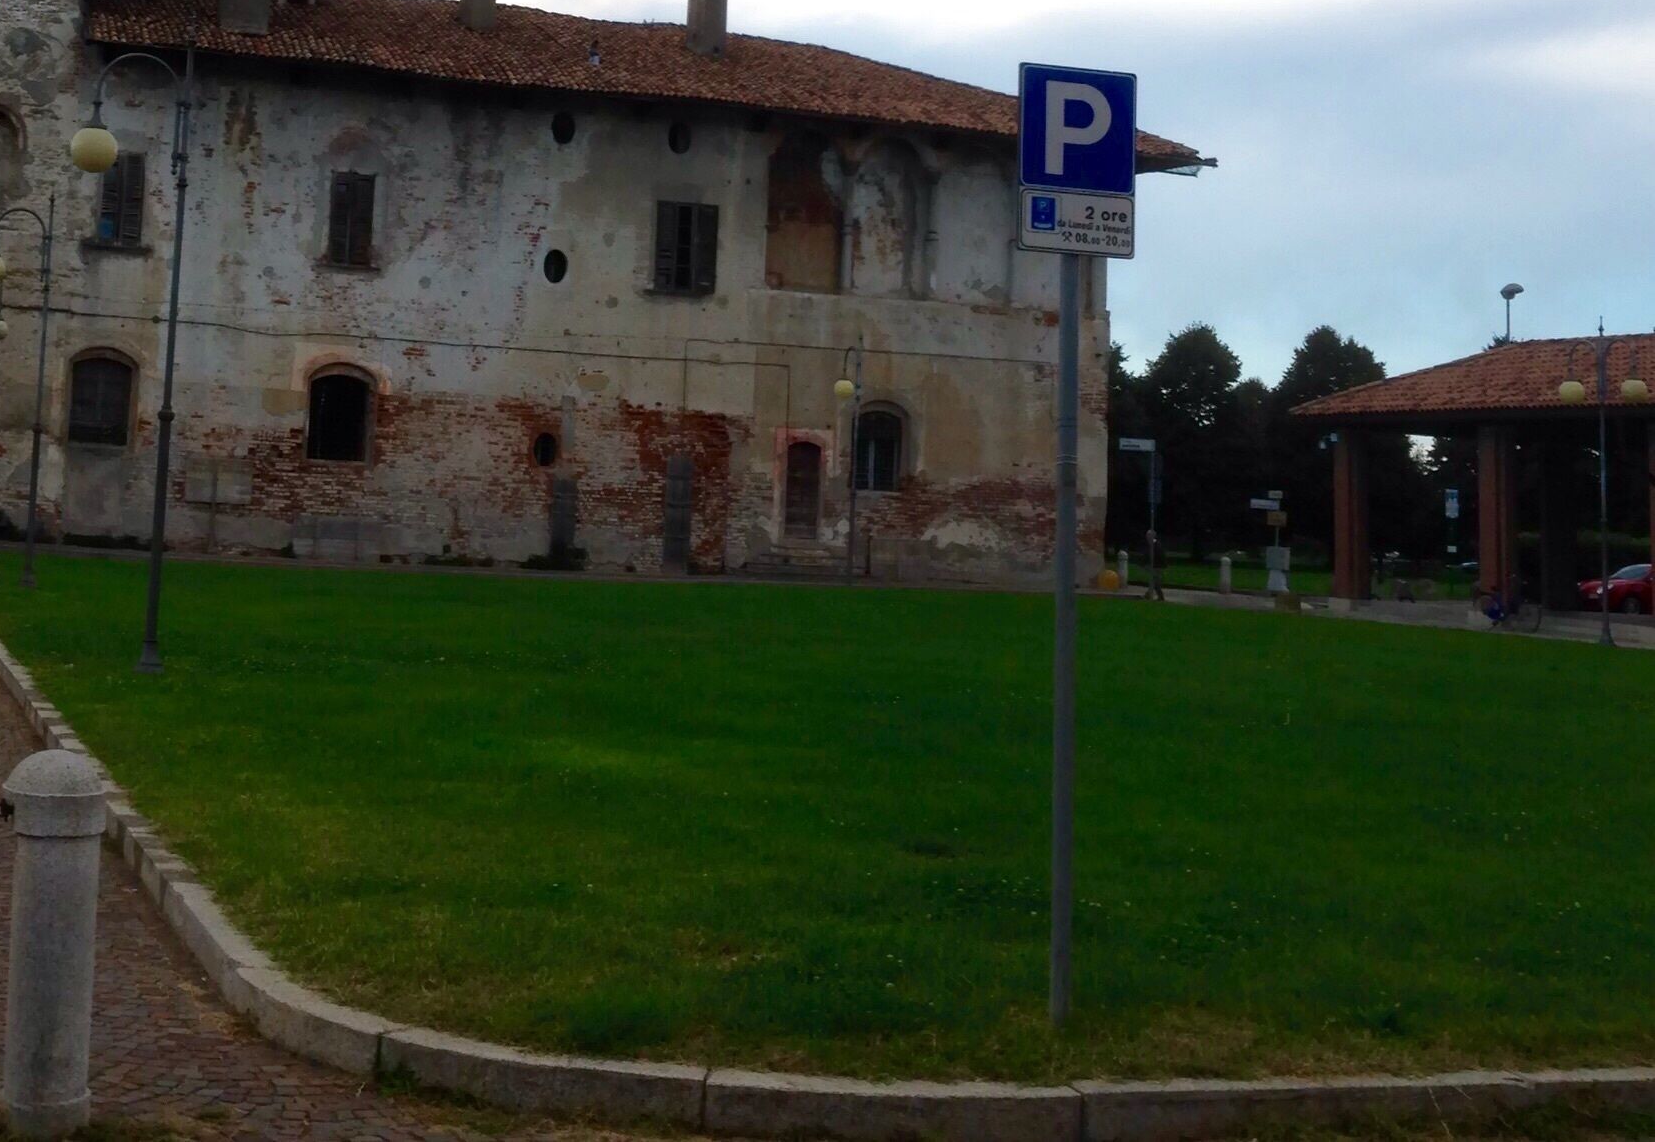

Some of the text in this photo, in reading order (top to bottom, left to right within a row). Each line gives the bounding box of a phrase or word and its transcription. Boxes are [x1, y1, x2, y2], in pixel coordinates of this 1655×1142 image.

[1045, 80, 1112, 175] P
[1085, 206, 1128, 223] 2 ore
